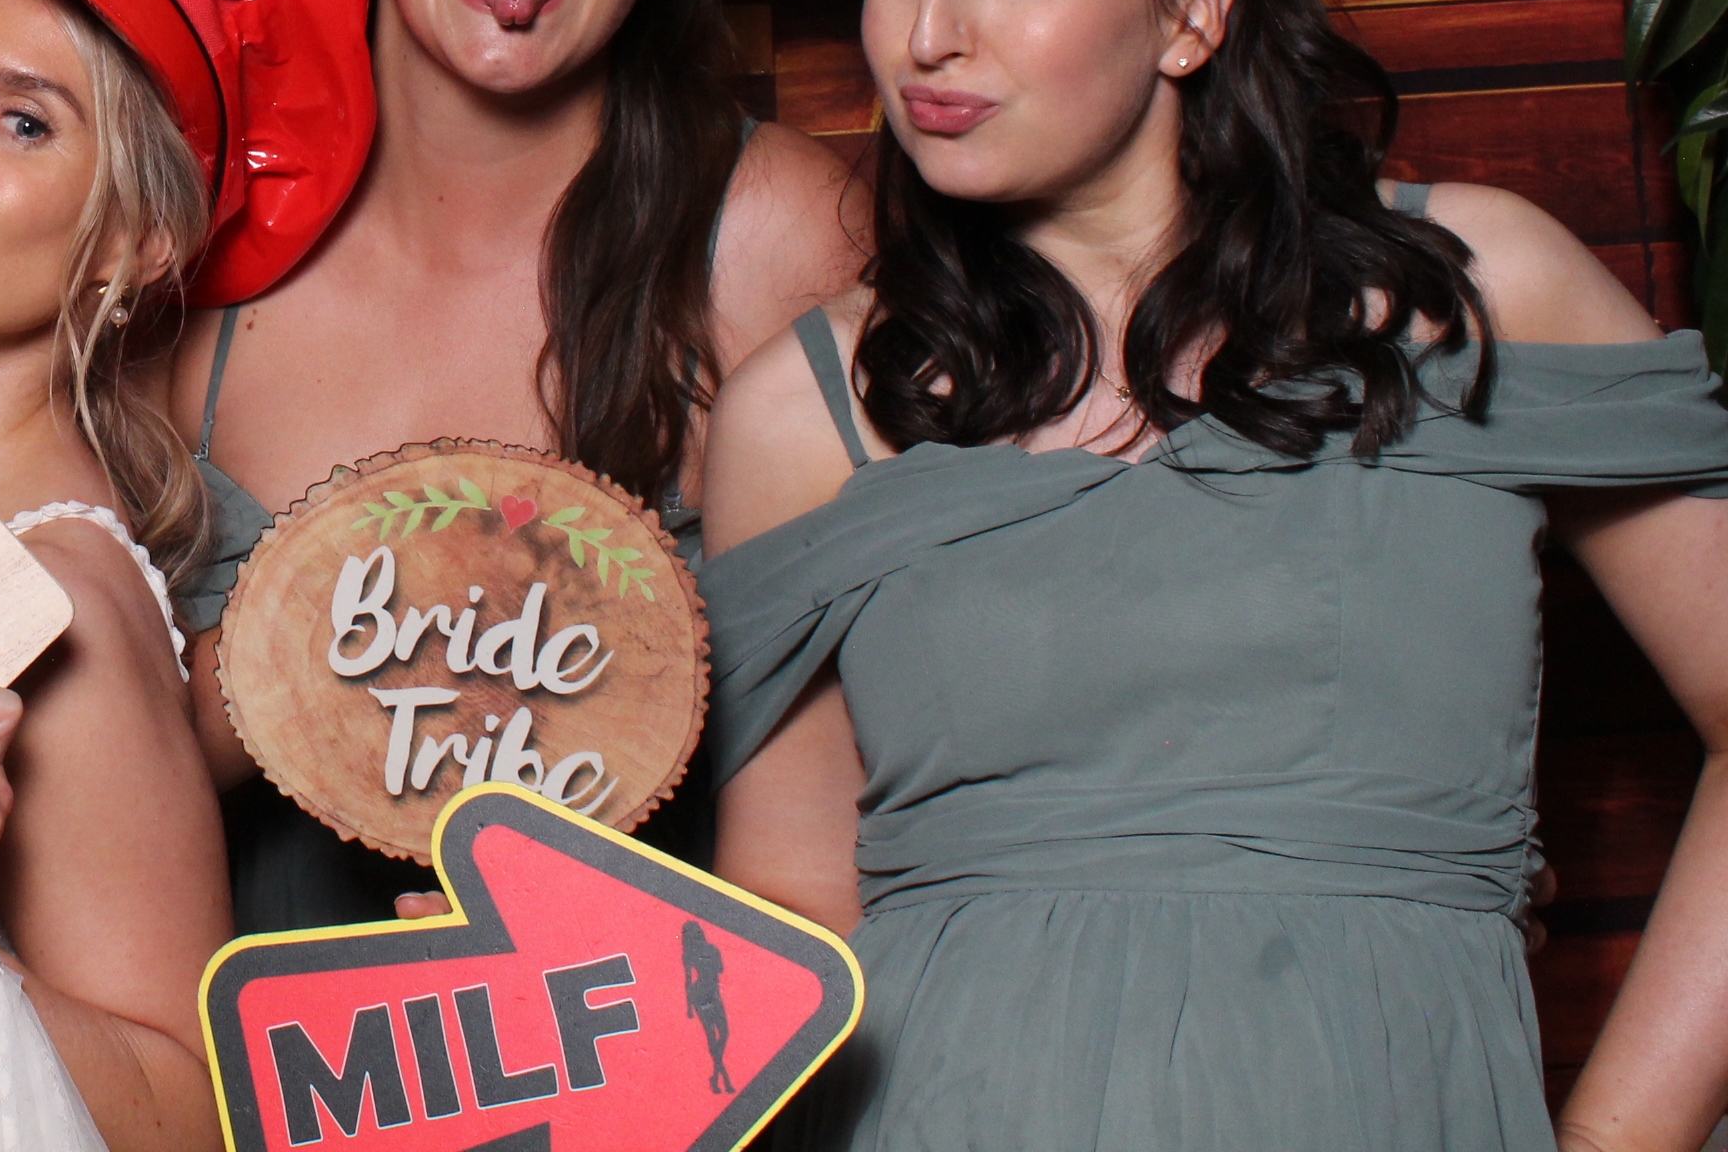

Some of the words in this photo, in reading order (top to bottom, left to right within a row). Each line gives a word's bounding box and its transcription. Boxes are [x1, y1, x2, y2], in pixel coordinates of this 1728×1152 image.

[328, 545, 615, 695] Bride
[367, 686, 620, 815] Tribe
[266, 952, 640, 1147] MILF
